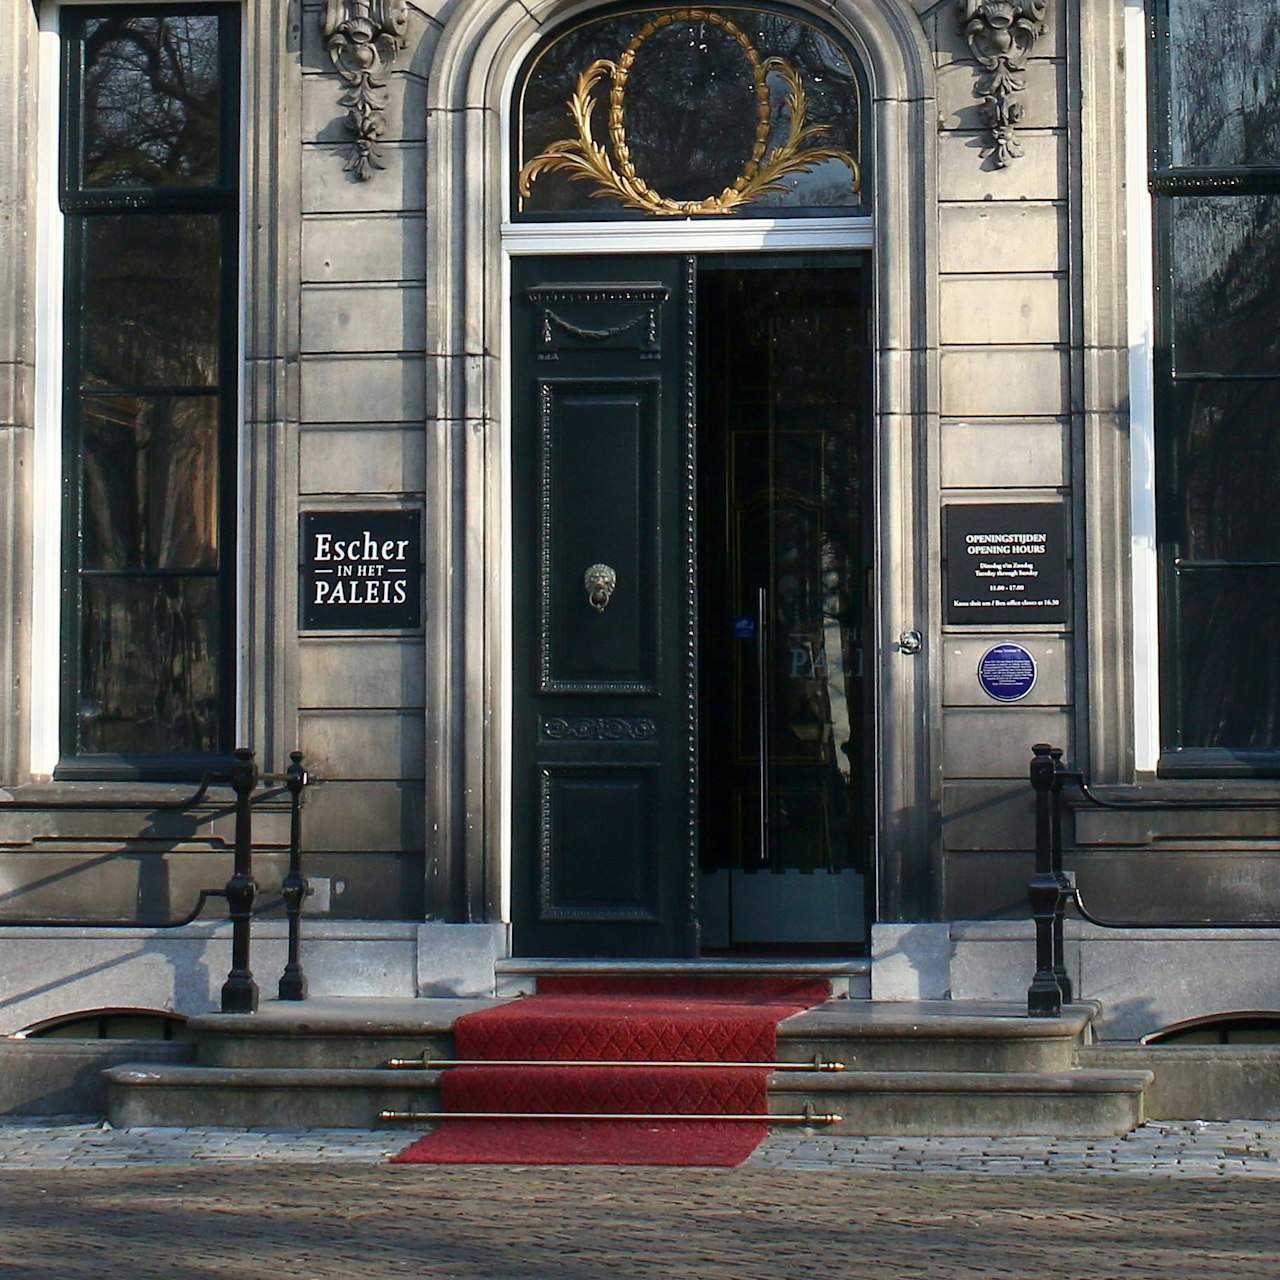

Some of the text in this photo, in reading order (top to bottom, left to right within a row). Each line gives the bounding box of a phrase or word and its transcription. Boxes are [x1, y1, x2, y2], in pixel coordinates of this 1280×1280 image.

[965, 533, 1046, 544] OPENINGSTIJDEN
[313, 531, 409, 561] Escher
[967, 545, 1046, 555] OPENING HOURS
[337, 564, 385, 577] IN HET
[313, 580, 407, 604] PALEIS
